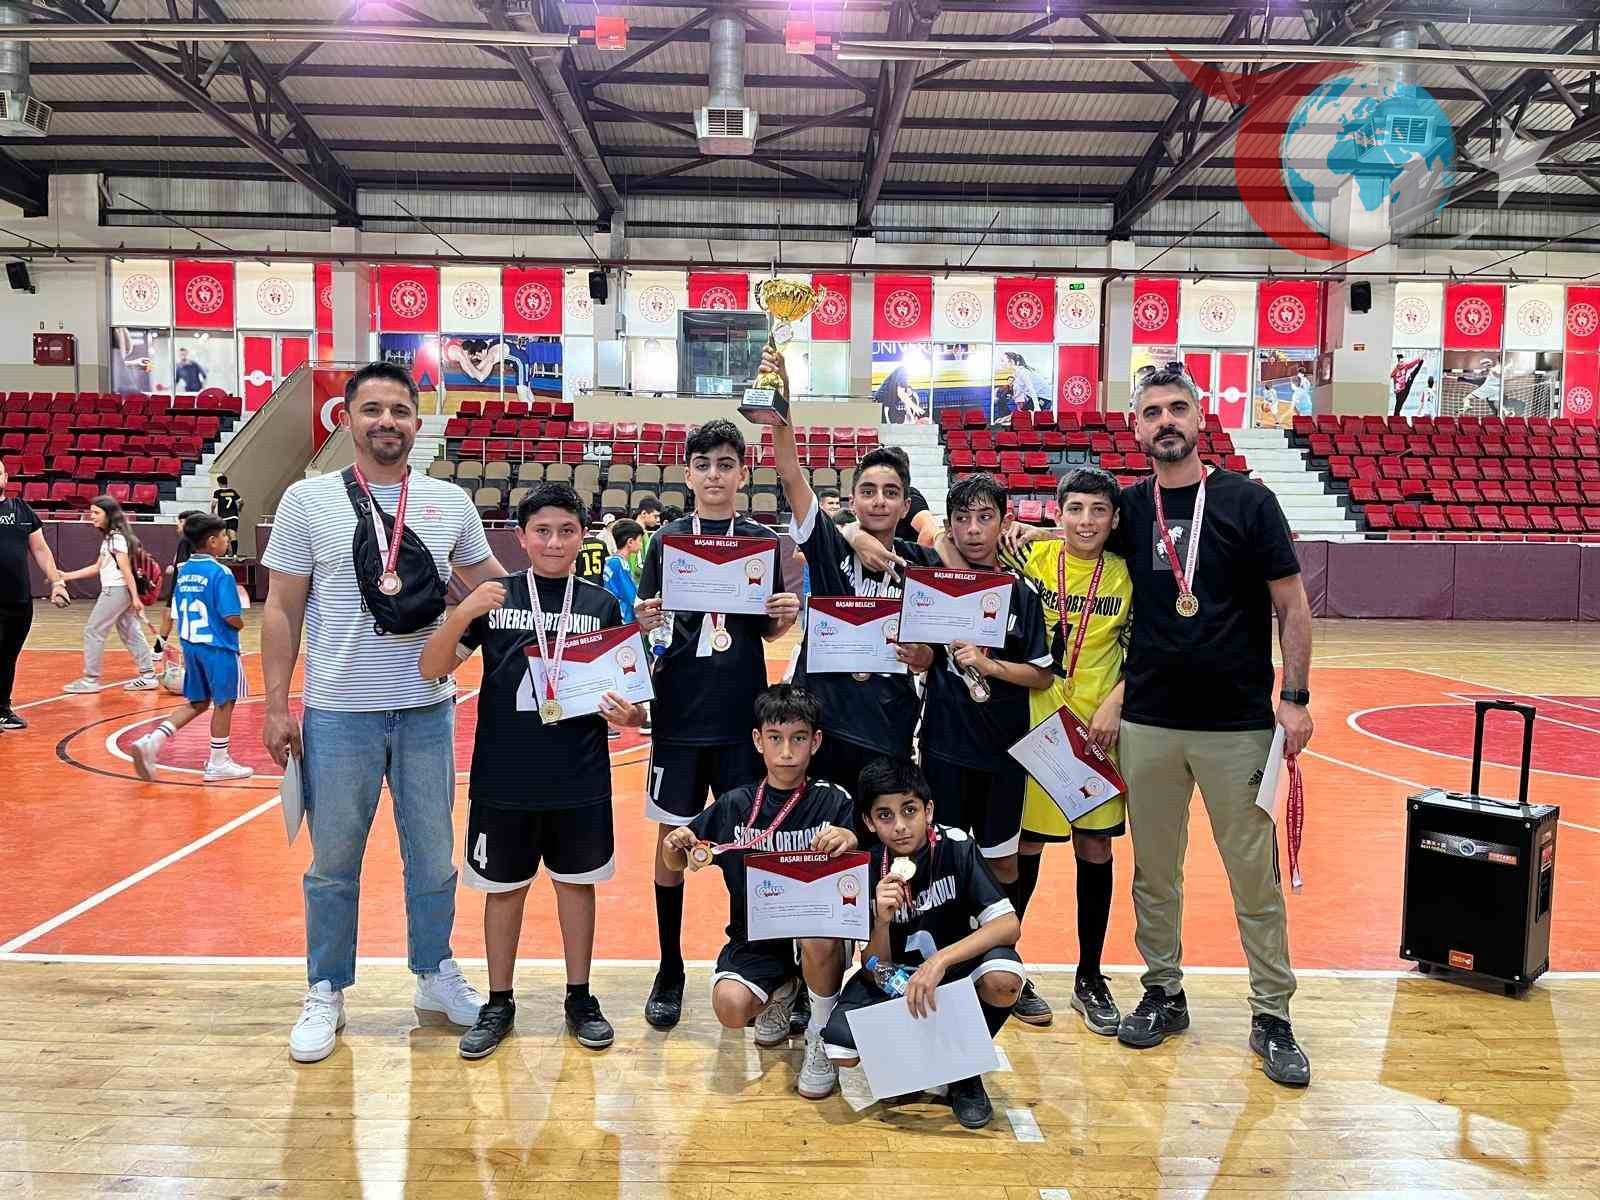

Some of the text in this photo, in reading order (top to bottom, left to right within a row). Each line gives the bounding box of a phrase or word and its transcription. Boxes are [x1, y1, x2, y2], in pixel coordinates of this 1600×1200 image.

[225, 497, 233, 509] 7
[582, 551, 602, 576] 15
[180, 598, 214, 643] 12
[473, 832, 488, 869] 4
